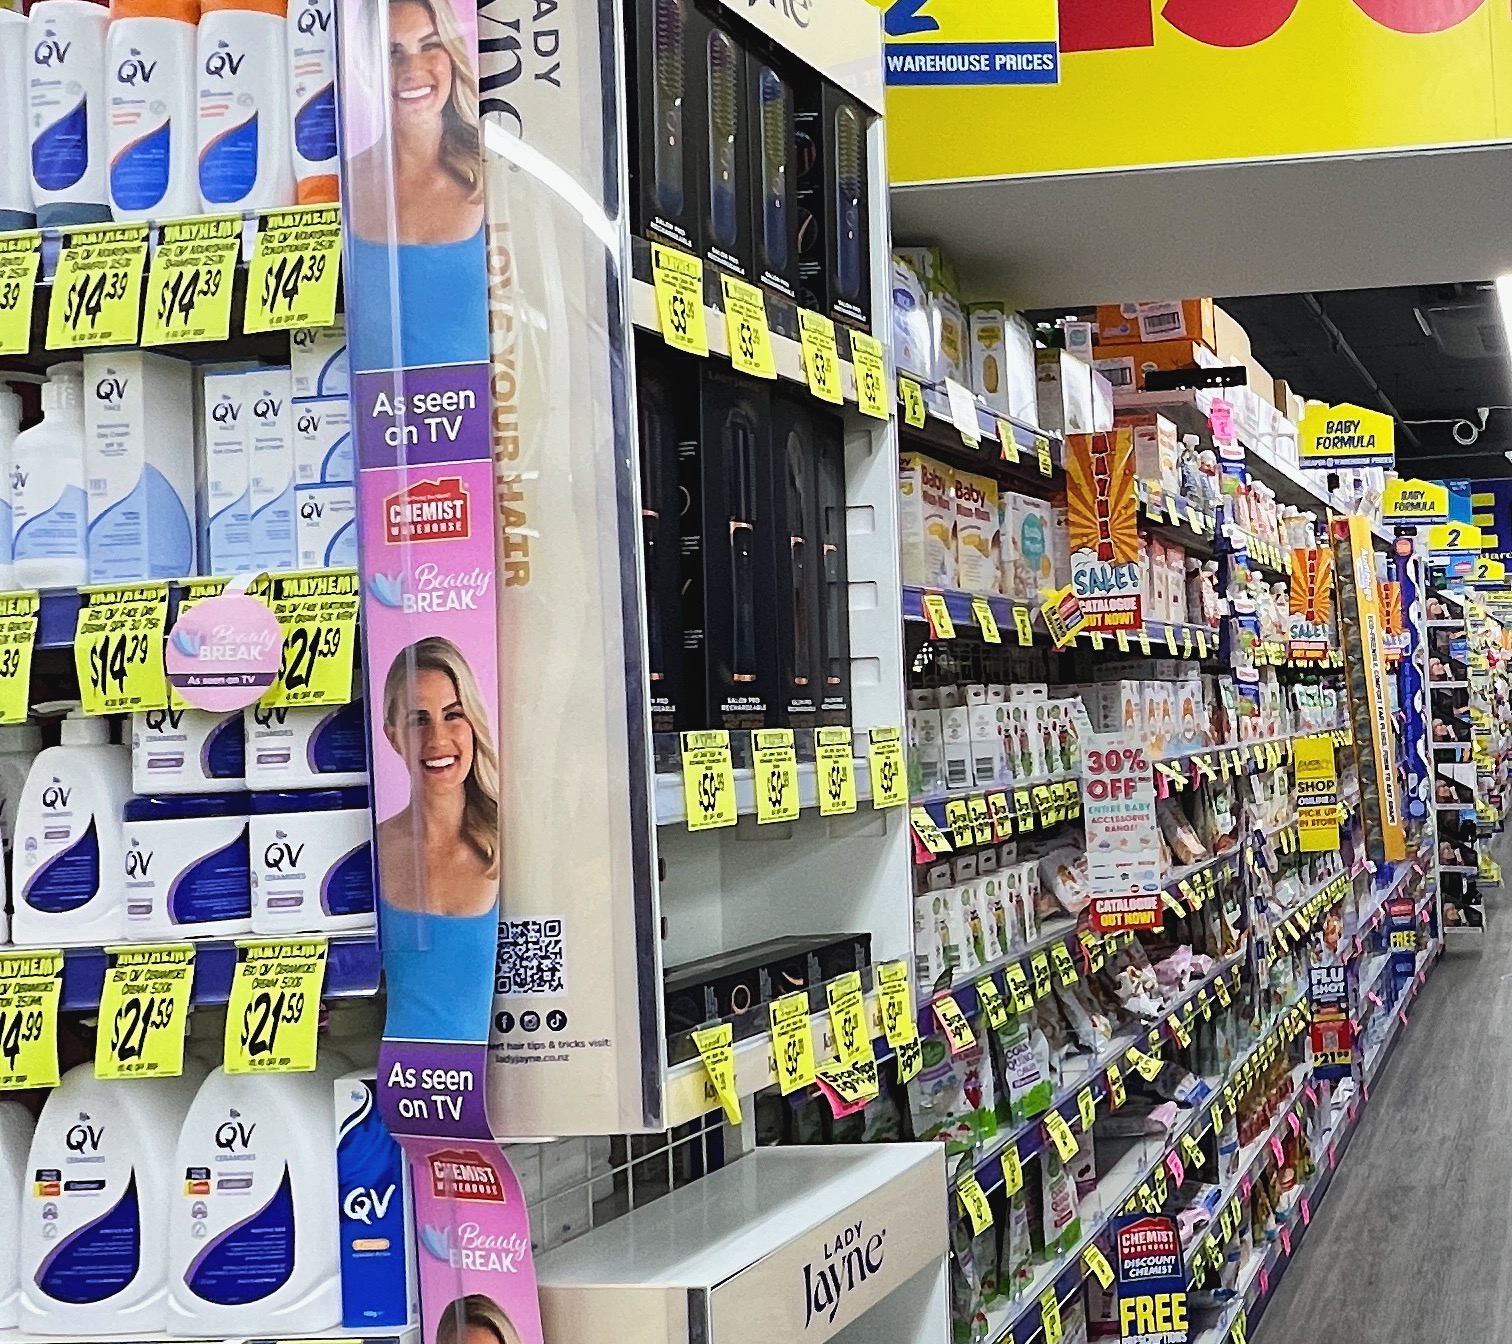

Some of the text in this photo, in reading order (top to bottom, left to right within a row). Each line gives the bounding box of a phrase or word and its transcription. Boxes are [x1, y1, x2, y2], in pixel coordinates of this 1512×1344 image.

[887, 53, 1054, 73] WAREHOUSE PRICES
[372, 389, 476, 418] As seen
[385, 415, 463, 446] on TV
[1326, 420, 1360, 434] BABY
[1316, 435, 1375, 449] FORMULA
[415, 563, 492, 596] Beauty
[1074, 564, 1138, 595] SALE!
[403, 589, 478, 614] BREAK
[1088, 748, 1149, 774] 30%
[1087, 777, 1136, 801] OFF
[1297, 780, 1335, 793] SHOP
[1390, 931, 1416, 948] FREE
[1311, 967, 1344, 984] FLU
[66, 1123, 104, 1152] QV
[343, 1184, 396, 1224] QV
[823, 1220, 863, 1259] LADY
[1122, 1231, 1174, 1247] CHEMIST
[1124, 1256, 1176, 1269] DISCOUNT
[803, 1229, 888, 1330] Jayne
[1120, 1293, 1189, 1337] FREE
